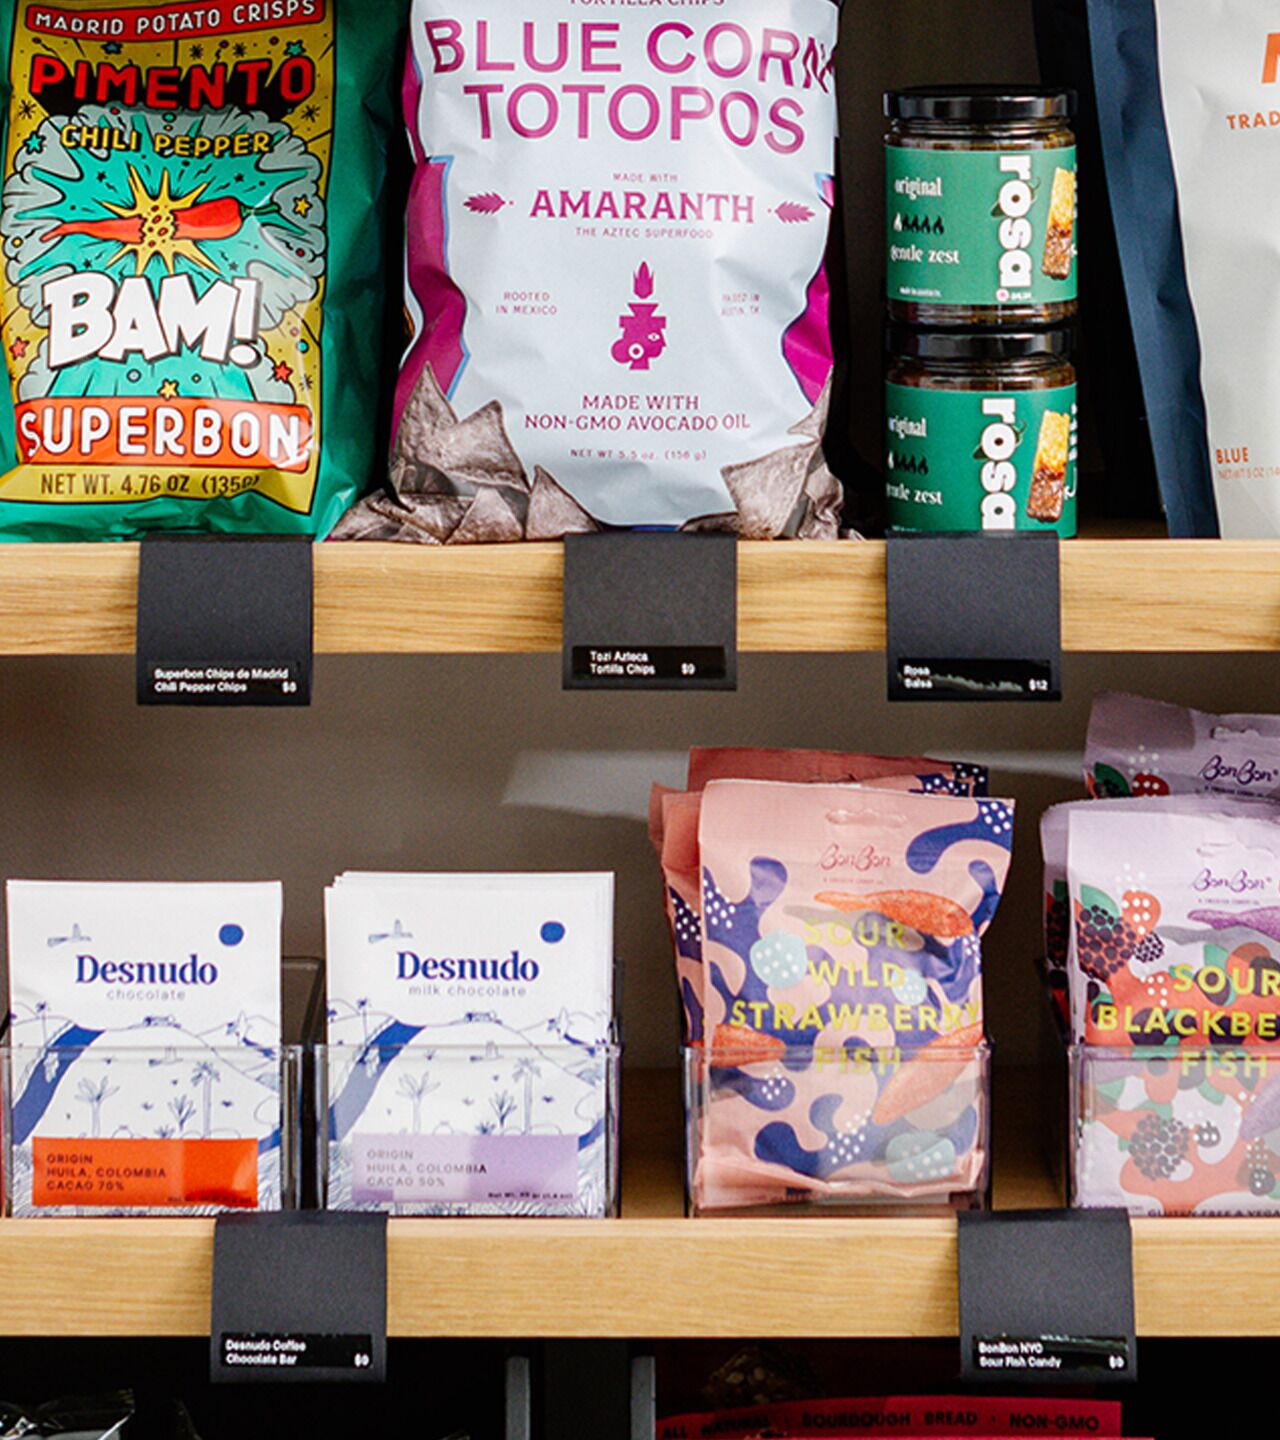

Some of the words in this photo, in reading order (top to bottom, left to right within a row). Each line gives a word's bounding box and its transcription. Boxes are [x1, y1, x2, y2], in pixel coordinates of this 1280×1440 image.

[424, 19, 622, 74] BLUE
[646, 21, 834, 94] CORN
[29, 55, 314, 109] PIMENTO
[464, 83, 804, 154] TOTOPOS
[61, 124, 136, 151] CHILI
[154, 132, 272, 156] PEPPER
[529, 190, 754, 224] AMARANTH
[44, 272, 261, 368] BAM!
[582, 395, 640, 410] MADE
[646, 395, 699, 410] WITH
[525, 414, 620, 430] NON-GMO
[627, 415, 718, 431] AVOCADO
[722, 413, 750, 429] OIL
[590, 651, 612, 662] Tozi
[614, 651, 648, 662] Azteca
[590, 663, 624, 675] Tortilla
[626, 664, 656, 675] Chips
[154, 668, 204, 680] Superbon
[206, 668, 234, 680] Chips
[252, 668, 288, 679] Madrid
[154, 682, 178, 692] Chili
[180, 682, 215, 693] Pepper
[217, 681, 247, 692] Chips
[804, 919, 905, 947] SOUR
[75, 954, 218, 986] Desnudo
[396, 950, 539, 983] Desnudo
[809, 961, 905, 988] WILD
[730, 999, 980, 1030] STRAWBERRY
[226, 1353, 277, 1365] Chocolate
[279, 1354, 297, 1365] Bar
